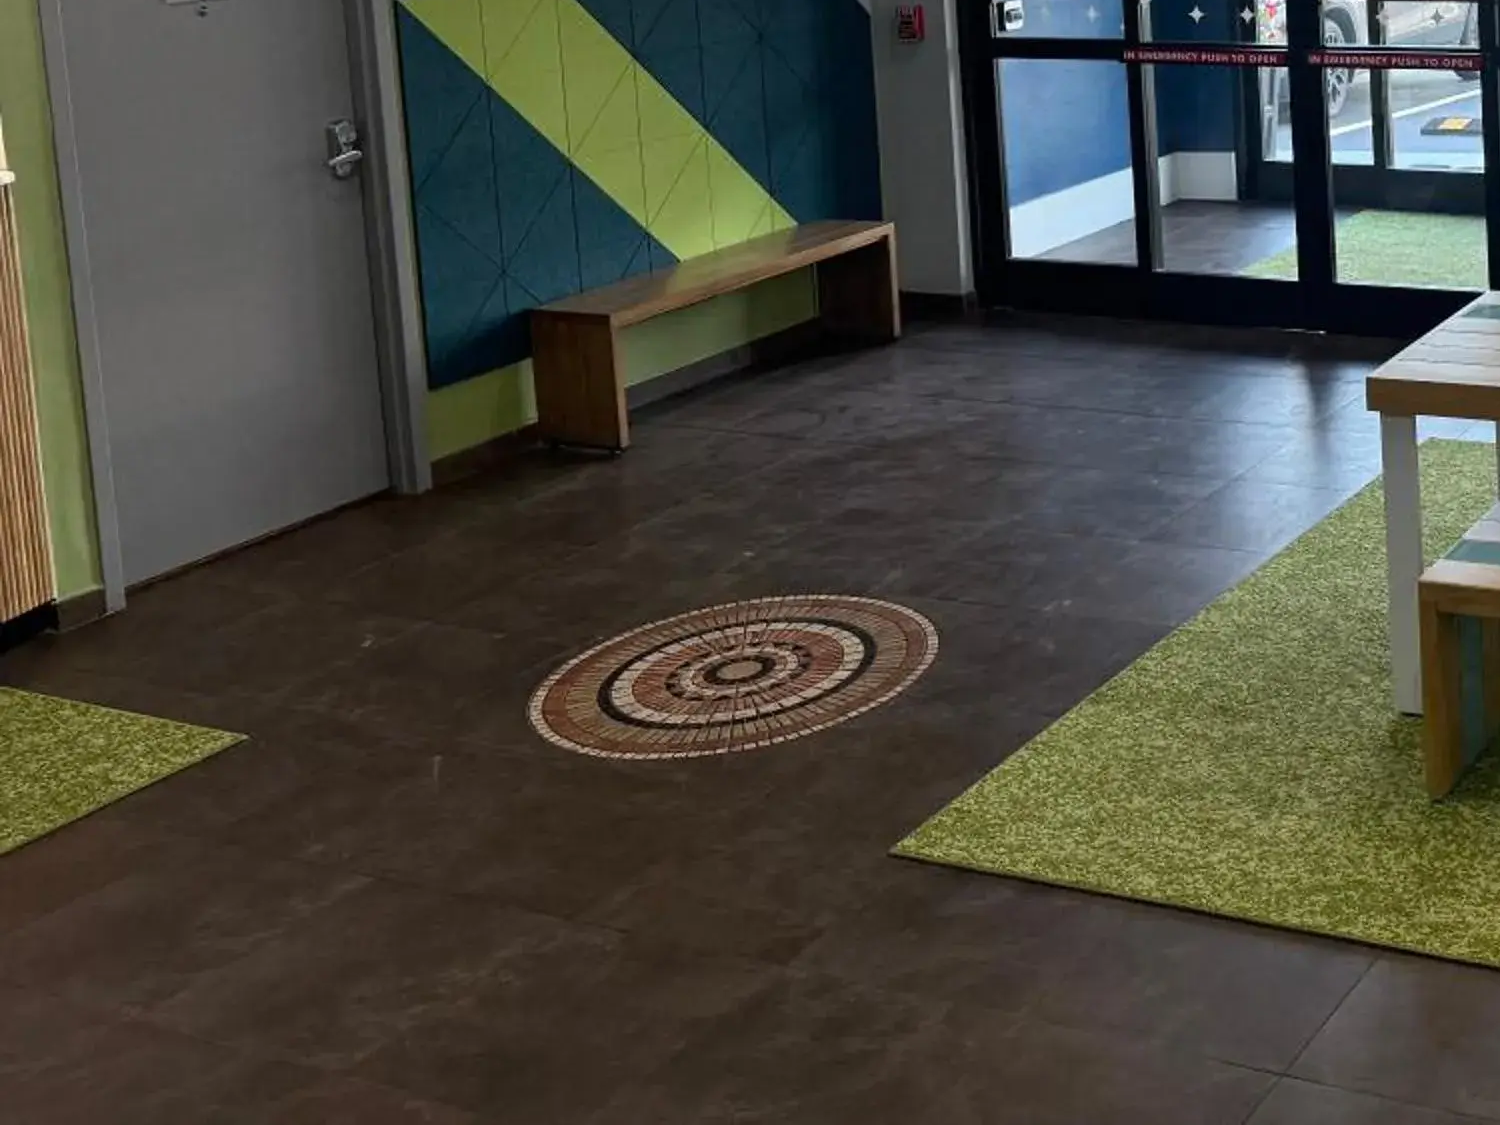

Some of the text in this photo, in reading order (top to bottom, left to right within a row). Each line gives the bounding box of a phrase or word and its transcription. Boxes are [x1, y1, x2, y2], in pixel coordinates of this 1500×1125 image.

[1123, 50, 1278, 64] IN EMERGENCY PUSH TO OPEN
[1309, 55, 1473, 68] IN EMERGENCY PUSH TO OPEN
